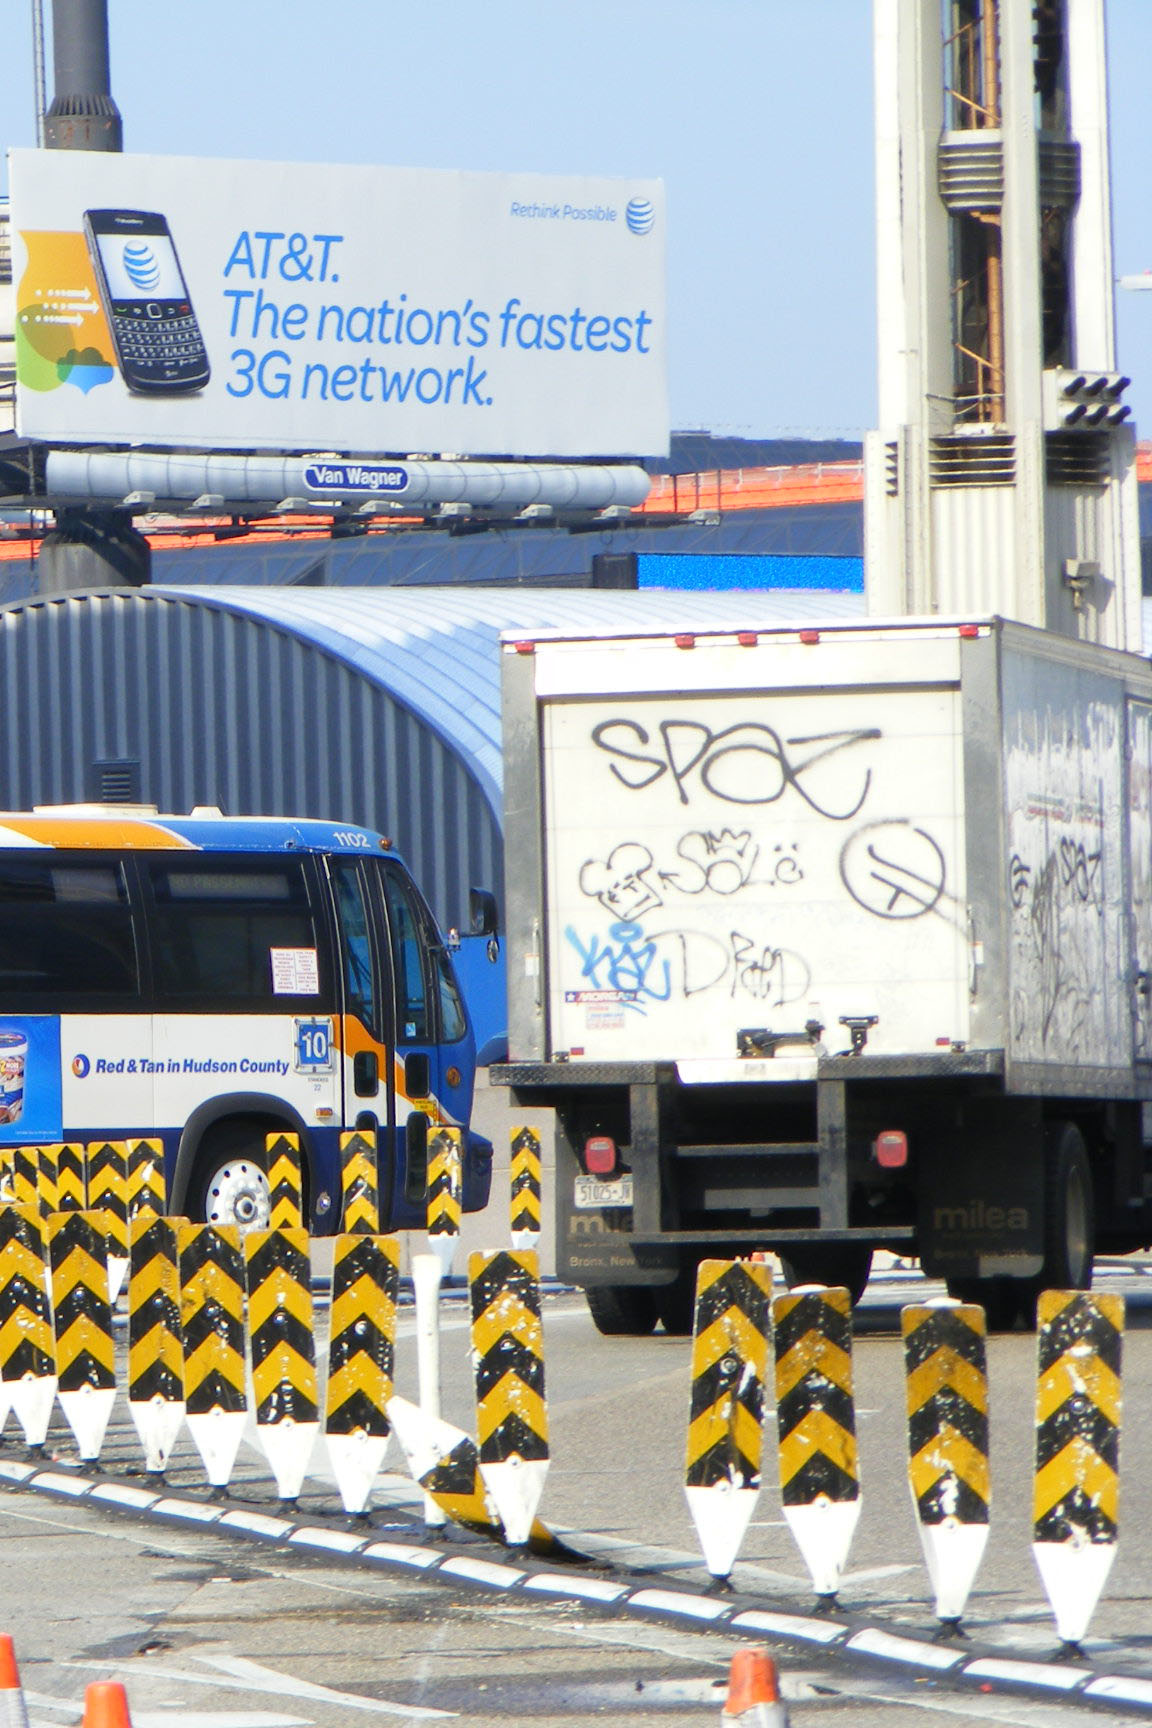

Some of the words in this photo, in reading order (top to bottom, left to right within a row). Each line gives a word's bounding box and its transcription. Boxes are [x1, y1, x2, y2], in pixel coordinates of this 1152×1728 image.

[510, 201, 560, 218] Rethink
[563, 205, 617, 222] Possible
[223, 231, 344, 283] AT&T.
[223, 289, 309, 340] The
[317, 294, 489, 348] nation's
[499, 299, 652, 354] fastest
[226, 349, 292, 399] 3G
[302, 356, 494, 406] network.
[313, 466, 344, 484] Van
[346, 467, 403, 489] Wagner
[333, 832, 371, 848] 1102
[301, 1031, 327, 1058] 10
[96, 1059, 124, 1074] Red
[139, 1059, 164, 1073] Tan
[168, 1059, 180, 1073] in
[183, 1059, 237, 1073] Hudson
[240, 1059, 290, 1076] County
[934, 1200, 1028, 1230] milea
